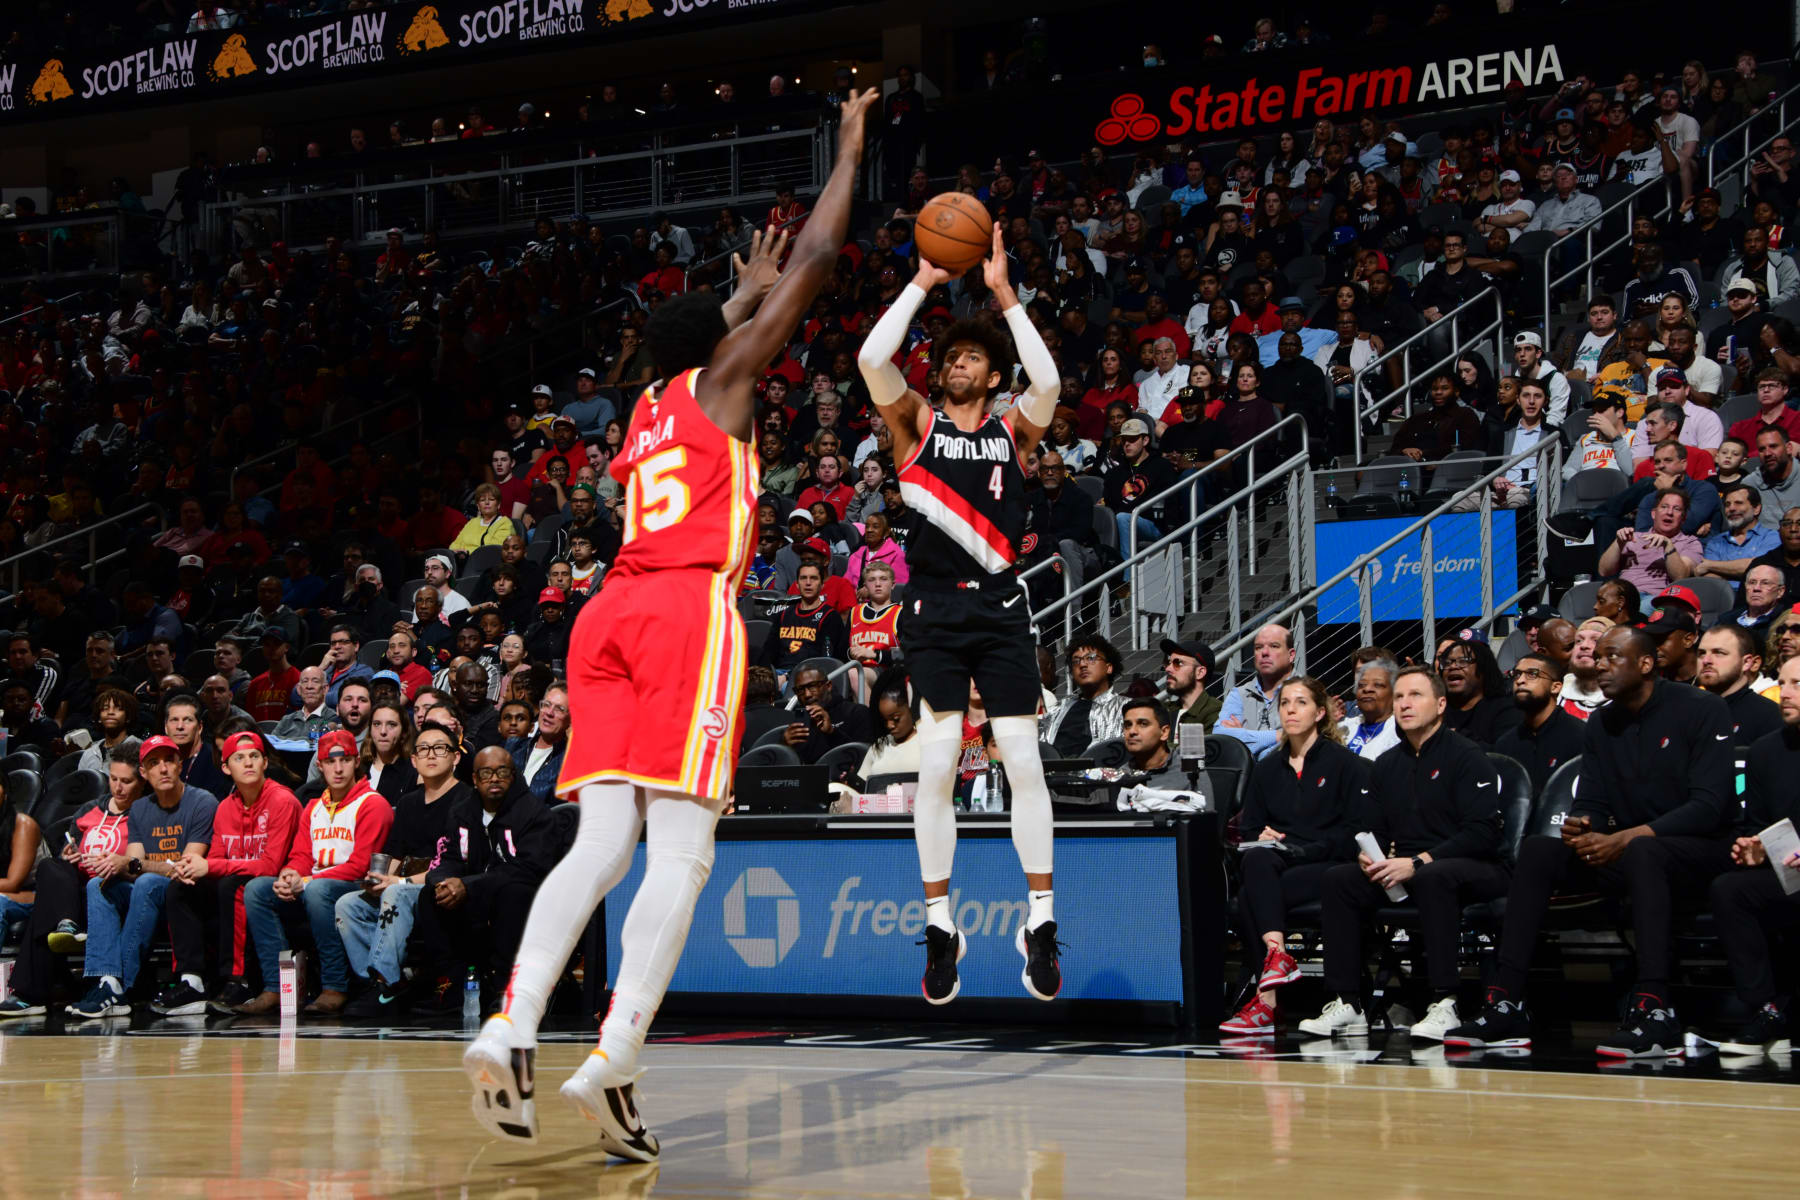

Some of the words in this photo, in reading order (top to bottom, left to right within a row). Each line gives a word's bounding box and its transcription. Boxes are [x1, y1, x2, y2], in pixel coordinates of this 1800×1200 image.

[519, 18, 566, 40] BREWING
[568, 14, 585, 32] CO.
[266, 12, 387, 75] SCOFFLAW
[323, 45, 368, 68] BREWING
[370, 42, 386, 62] CO.
[82, 39, 197, 99] SCOFFLAW
[136, 72, 179, 94] BREWING
[180, 69, 196, 88] CO.
[1166, 77, 1286, 136] State
[1291, 65, 1413, 119] Farm
[1417, 44, 1565, 102] ARENA
[933, 433, 1010, 463] PORTLAND
[1583, 449, 1617, 464] ATLAN
[623, 444, 691, 546] 15
[988, 465, 1004, 500] 4
[1391, 553, 1475, 584] fredom
[779, 625, 817, 642] HAWKS
[789, 641, 803, 654] 5
[761, 779, 800, 788] SCEPTRE
[313, 826, 353, 842] TLANTA
